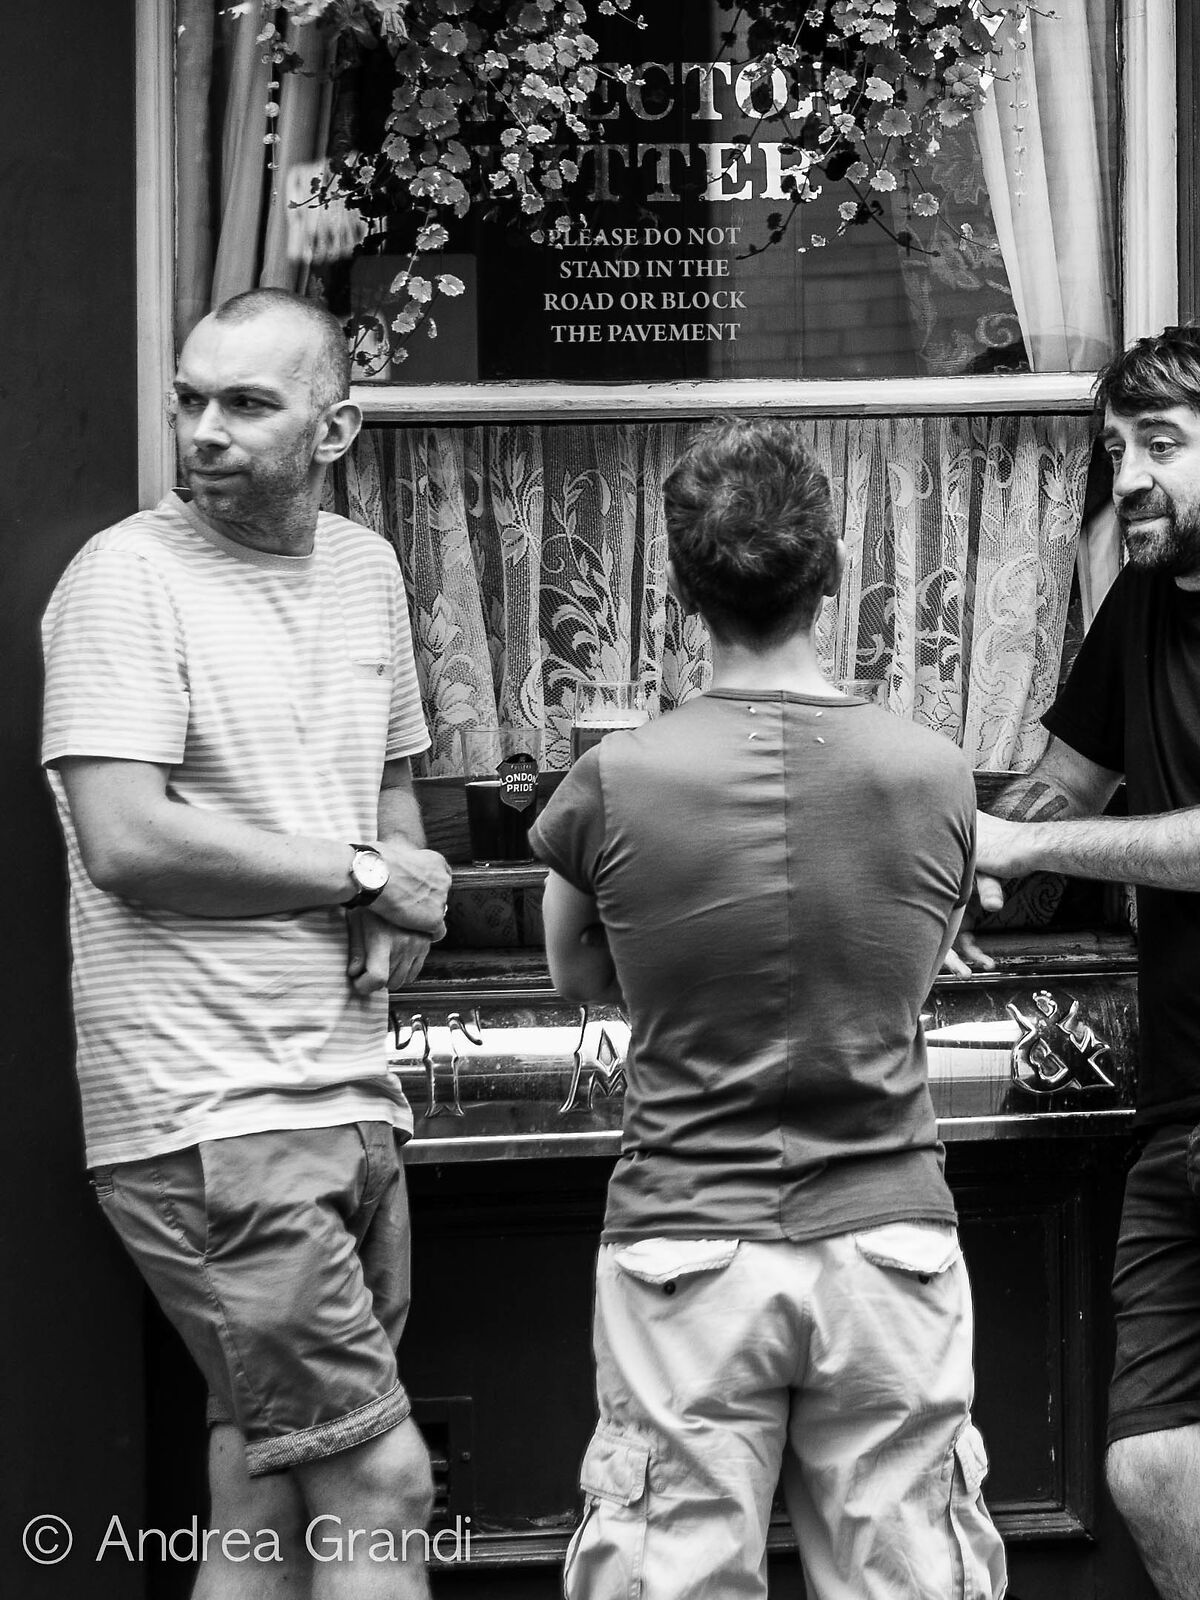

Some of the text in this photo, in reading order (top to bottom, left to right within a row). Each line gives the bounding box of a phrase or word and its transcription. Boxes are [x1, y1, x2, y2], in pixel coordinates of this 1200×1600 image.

[547, 226, 741, 247] PLEASE DO NOT
[559, 259, 731, 279] STAND IN THE
[543, 290, 747, 311] ROAD OR BLOCK
[550, 323, 741, 343] THE PAVEMENT
[499, 772, 538, 786] LONDON
[506, 783, 534, 793] PRIDE
